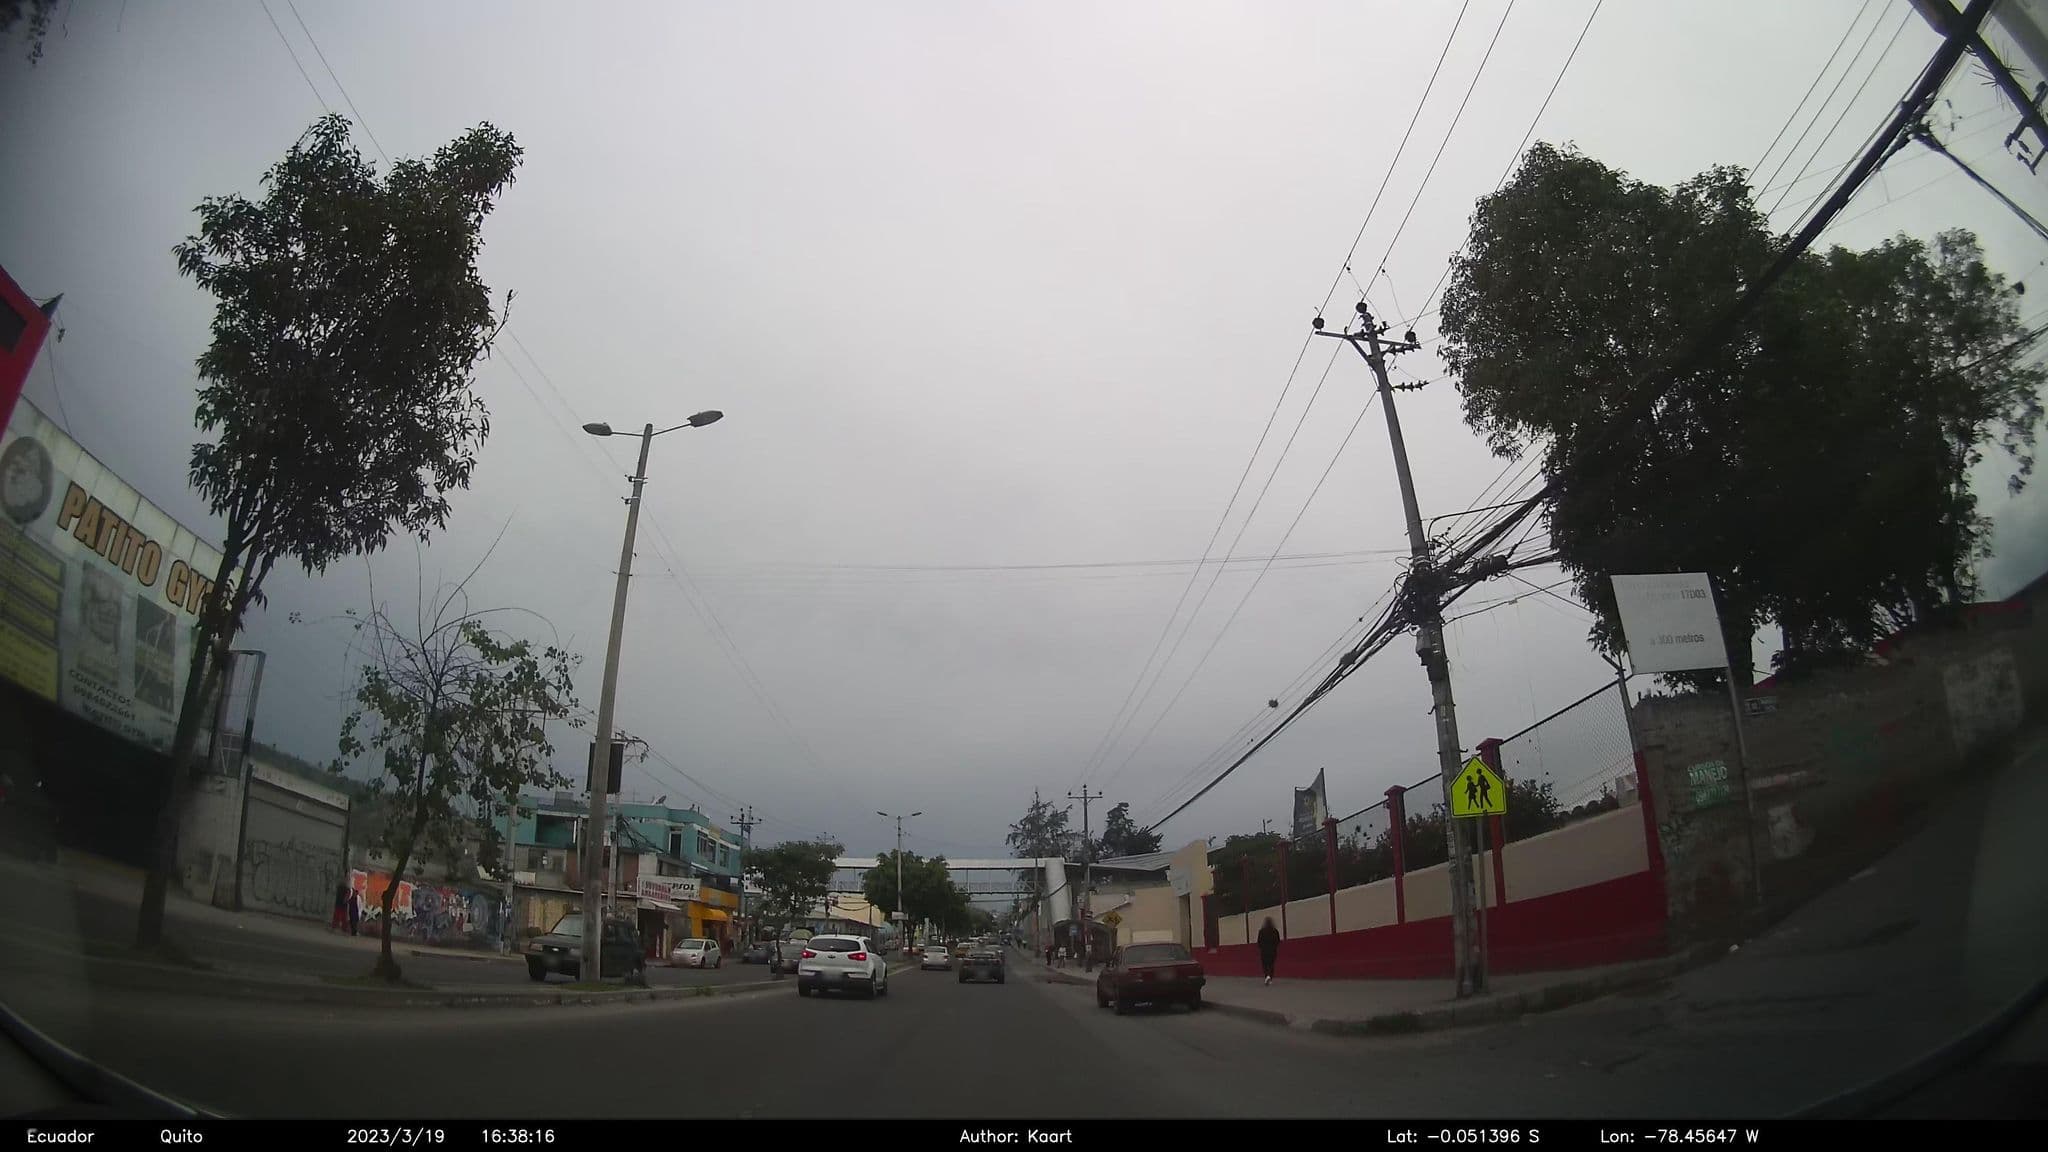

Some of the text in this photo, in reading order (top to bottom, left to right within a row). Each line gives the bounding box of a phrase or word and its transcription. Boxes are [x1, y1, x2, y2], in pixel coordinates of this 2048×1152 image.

[57, 480, 163, 587] PATITO
[1674, 632, 1705, 645] metros
[69, 669, 132, 706] CONTACTOS
